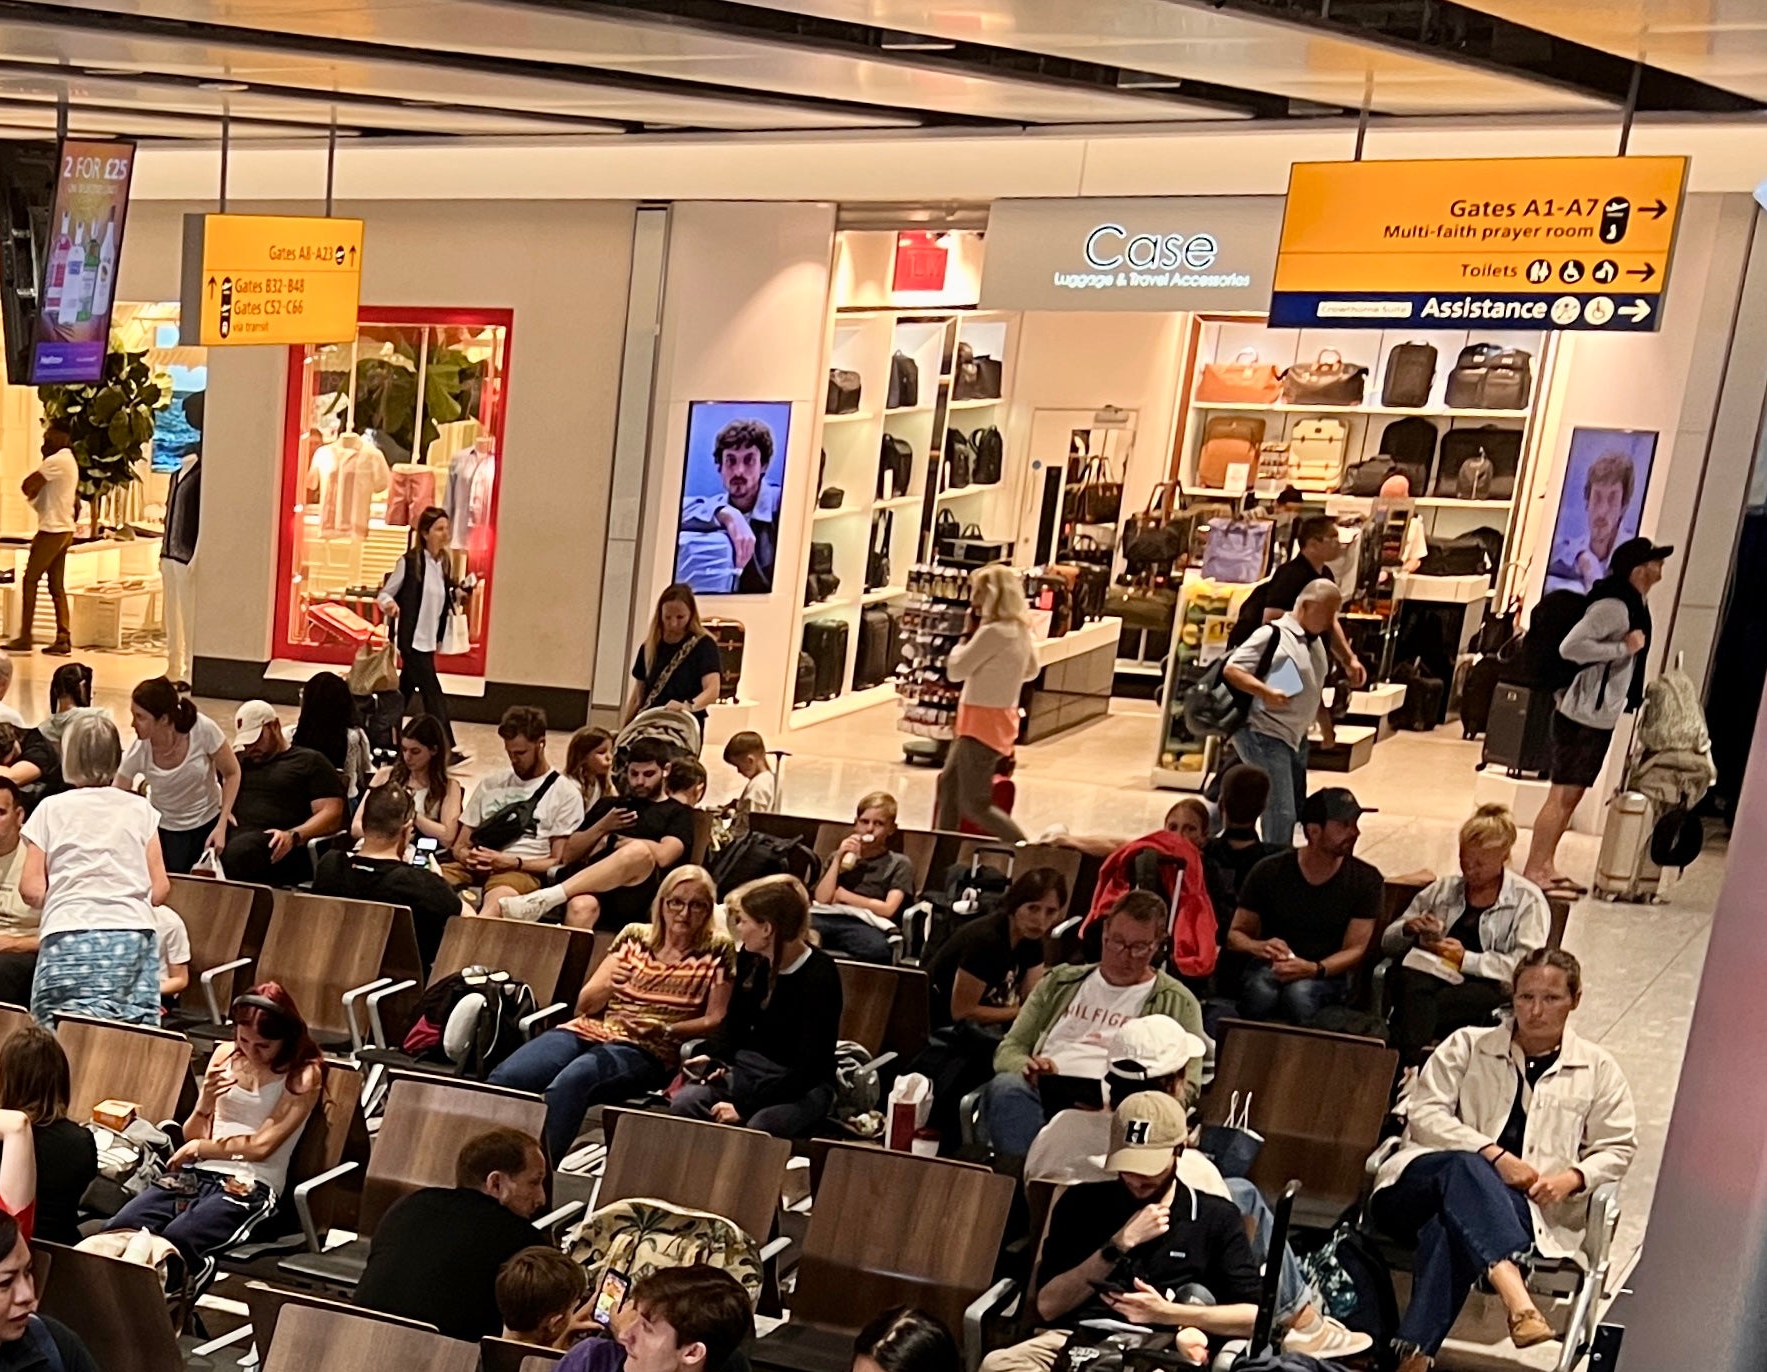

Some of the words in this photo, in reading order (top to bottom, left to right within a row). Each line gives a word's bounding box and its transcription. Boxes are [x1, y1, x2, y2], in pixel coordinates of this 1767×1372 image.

[63, 156, 73, 178] 2
[75, 156, 102, 179] FOR
[104, 158, 128, 180] £25
[1449, 199, 1516, 218] Gates
[1522, 199, 1600, 218] A1-A7
[1383, 224, 1477, 240] Multi-faith
[1482, 226, 1540, 243] prayer
[1545, 226, 1594, 239] room
[269, 245, 296, 261] Gates
[299, 246, 334, 261] A8-A23
[1085, 224, 1216, 269] Case
[1460, 263, 1518, 279] Toilets
[235, 279, 263, 294] Gates
[265, 279, 305, 293] B32-B48
[1054, 272, 1114, 288] Luggage
[1116, 273, 1127, 287] &
[1129, 272, 1169, 287] Travel
[1170, 272, 1250, 288] Accessories
[234, 300, 261, 315] Gates
[264, 300, 304, 315] C52-C66
[1421, 297, 1546, 320] Assistance
[233, 323, 243, 332] via
[245, 321, 269, 332] transit
[1125, 1120, 1150, 1144] H
